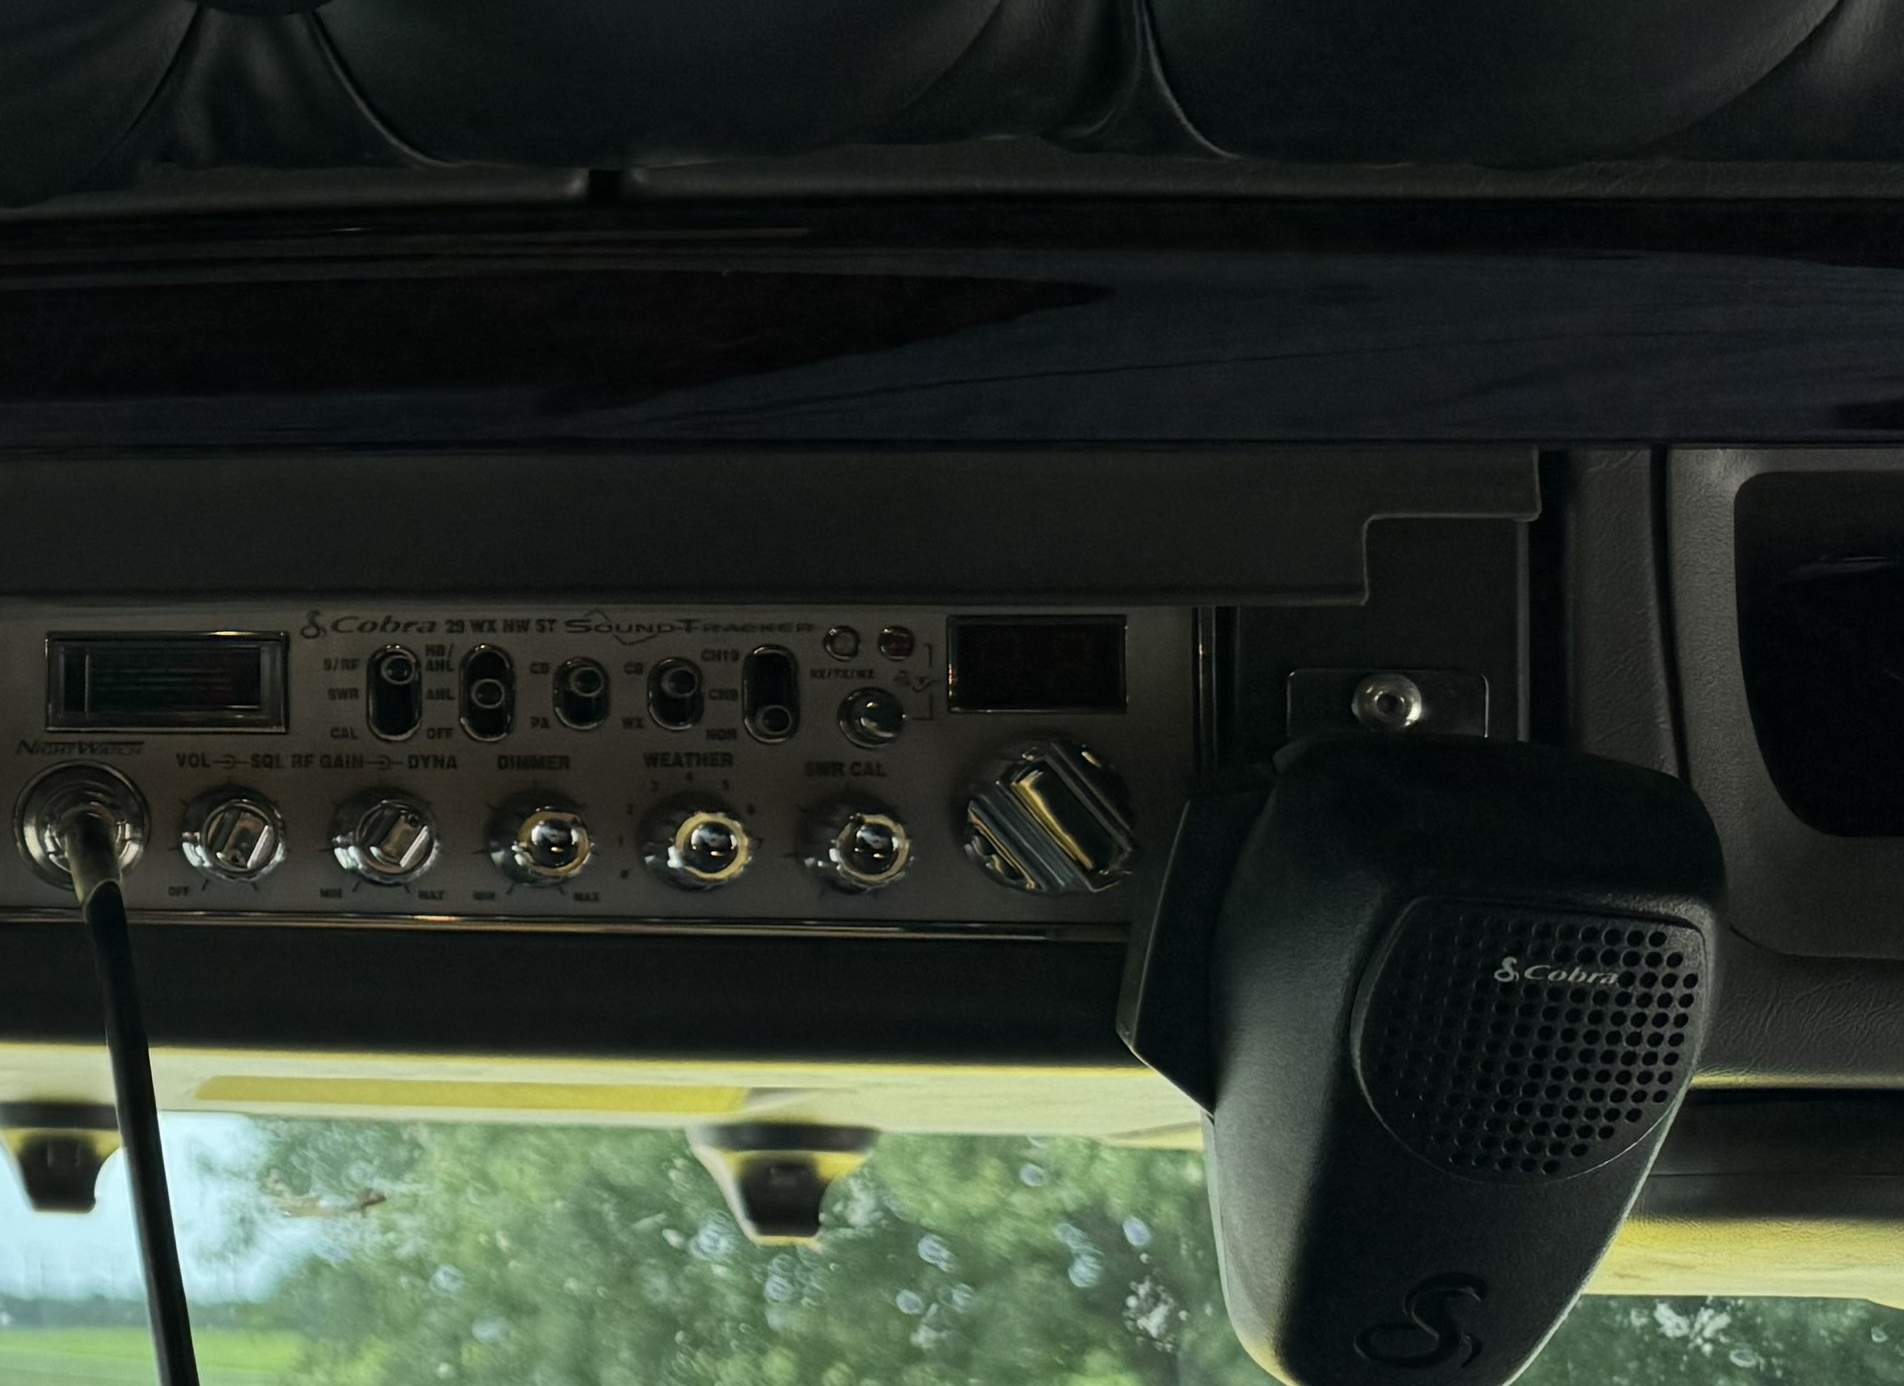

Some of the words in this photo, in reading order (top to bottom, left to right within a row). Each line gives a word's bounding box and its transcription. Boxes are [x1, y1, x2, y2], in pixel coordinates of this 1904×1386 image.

[330, 615, 437, 634] Cobra
[445, 619, 465, 634] 29
[471, 619, 497, 634] WX
[535, 619, 558, 634] ST
[327, 687, 360, 701] SWR
[330, 726, 358, 740] CAL
[426, 727, 454, 740] OFF
[176, 752, 210, 769] VOL
[250, 753, 285, 770] SQL
[291, 754, 313, 769] RF
[319, 754, 364, 770] GAIN
[408, 754, 458, 770] DYNA
[497, 754, 571, 770] DIMMER
[643, 752, 734, 768] WEATHER
[850, 762, 886, 777] CAL
[1523, 965, 1619, 985] Cobra
